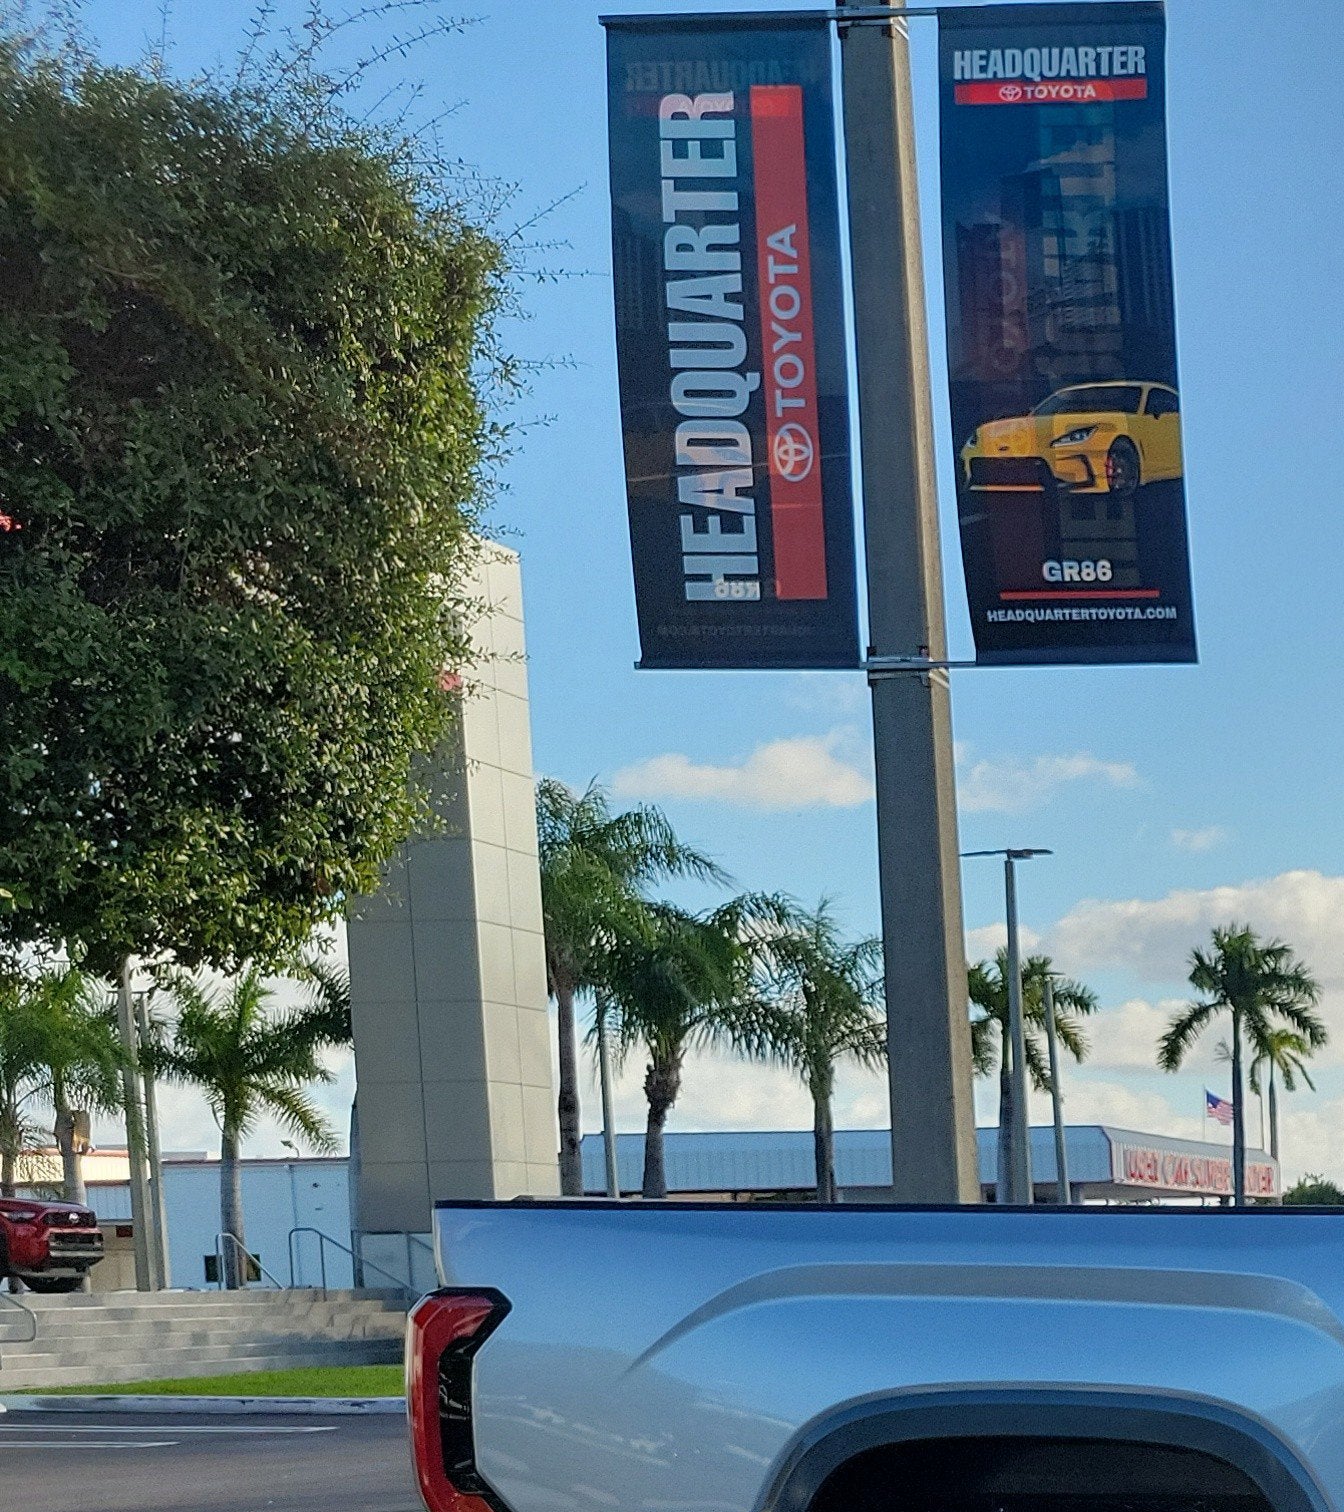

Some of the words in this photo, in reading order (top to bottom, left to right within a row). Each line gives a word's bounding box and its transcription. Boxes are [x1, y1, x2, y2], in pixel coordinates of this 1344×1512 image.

[953, 46, 1146, 82] HEADQUARTER
[1024, 84, 1096, 99] TOYOTA
[766, 224, 805, 417] TOYOTA
[659, 91, 761, 601] HEADQUARTER
[1042, 559, 1113, 583] GR86
[986, 605, 1178, 624] HEADQUARTERTOYOTA.COM
